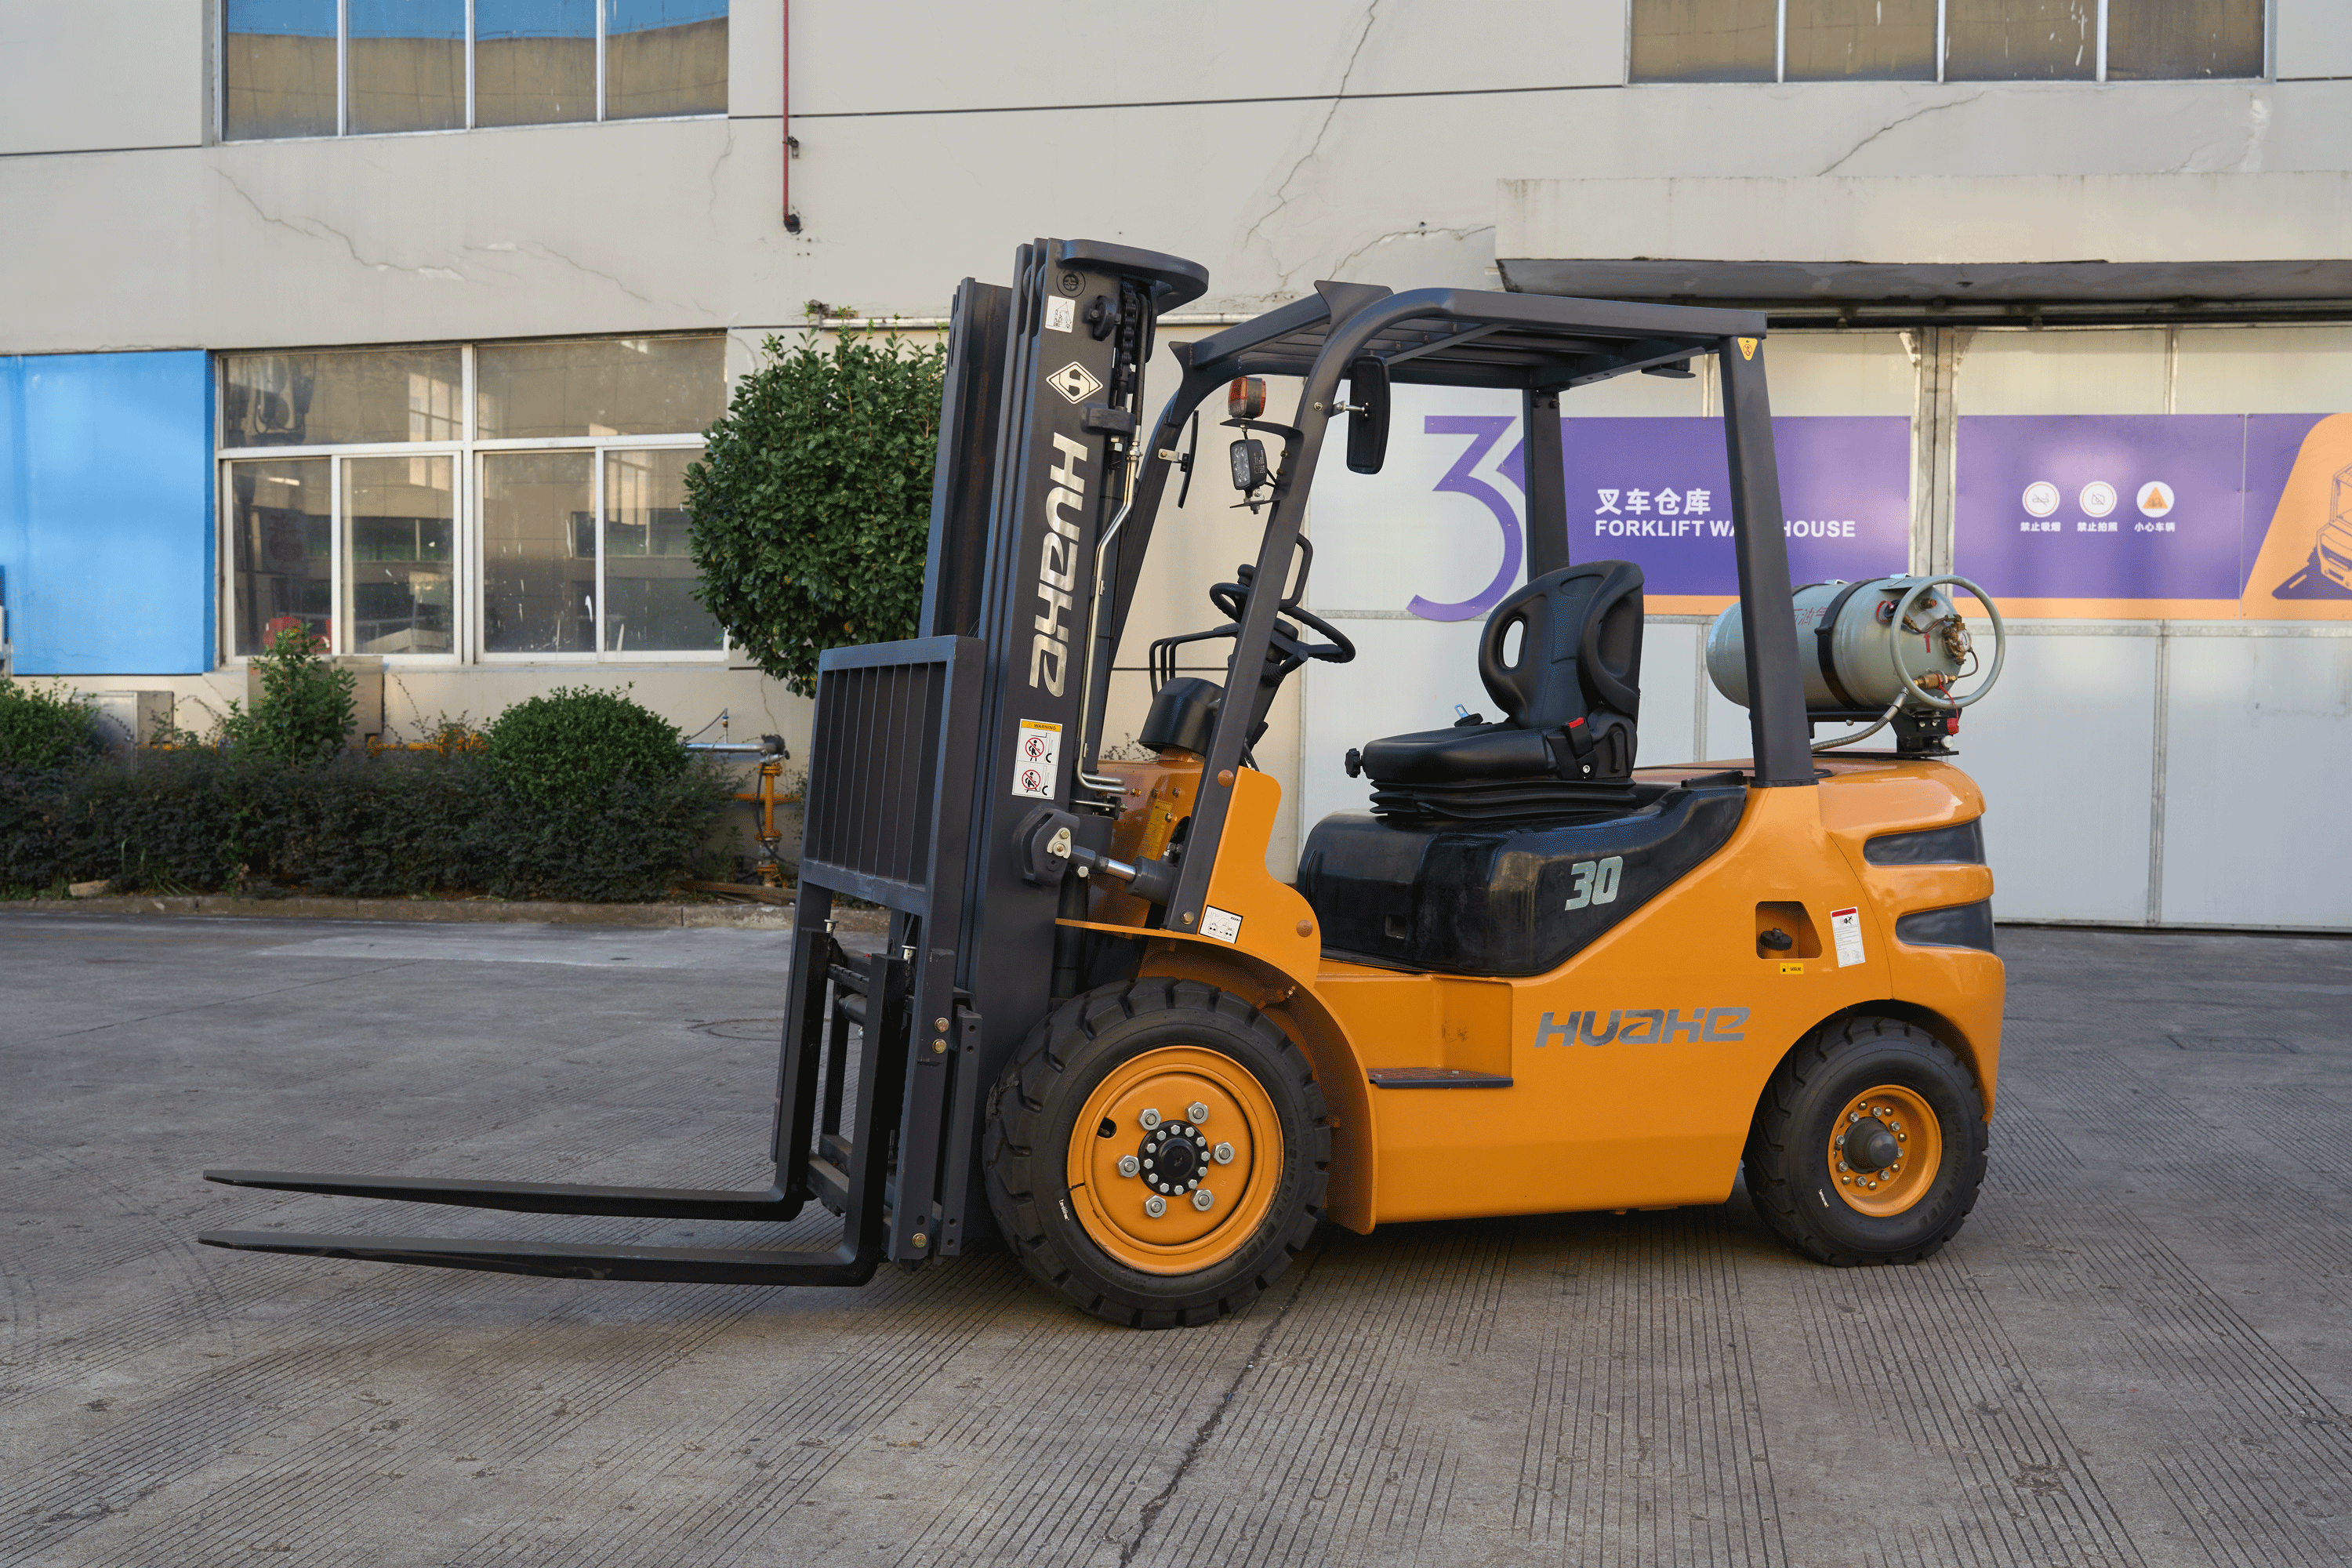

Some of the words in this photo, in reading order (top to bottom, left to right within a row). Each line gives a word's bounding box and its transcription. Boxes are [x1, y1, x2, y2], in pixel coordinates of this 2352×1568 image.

[1595, 488, 1711, 516] 叉车仓库
[1595, 520, 1704, 537] FORKLIFT
[1710, 520, 1856, 537] WHOUSE
[2020, 521, 2061, 532] 禁止吸烟
[2077, 521, 2118, 532] 禁止拍照
[2134, 521, 2176, 532] 小心车辆
[1565, 855, 1624, 911] 30
